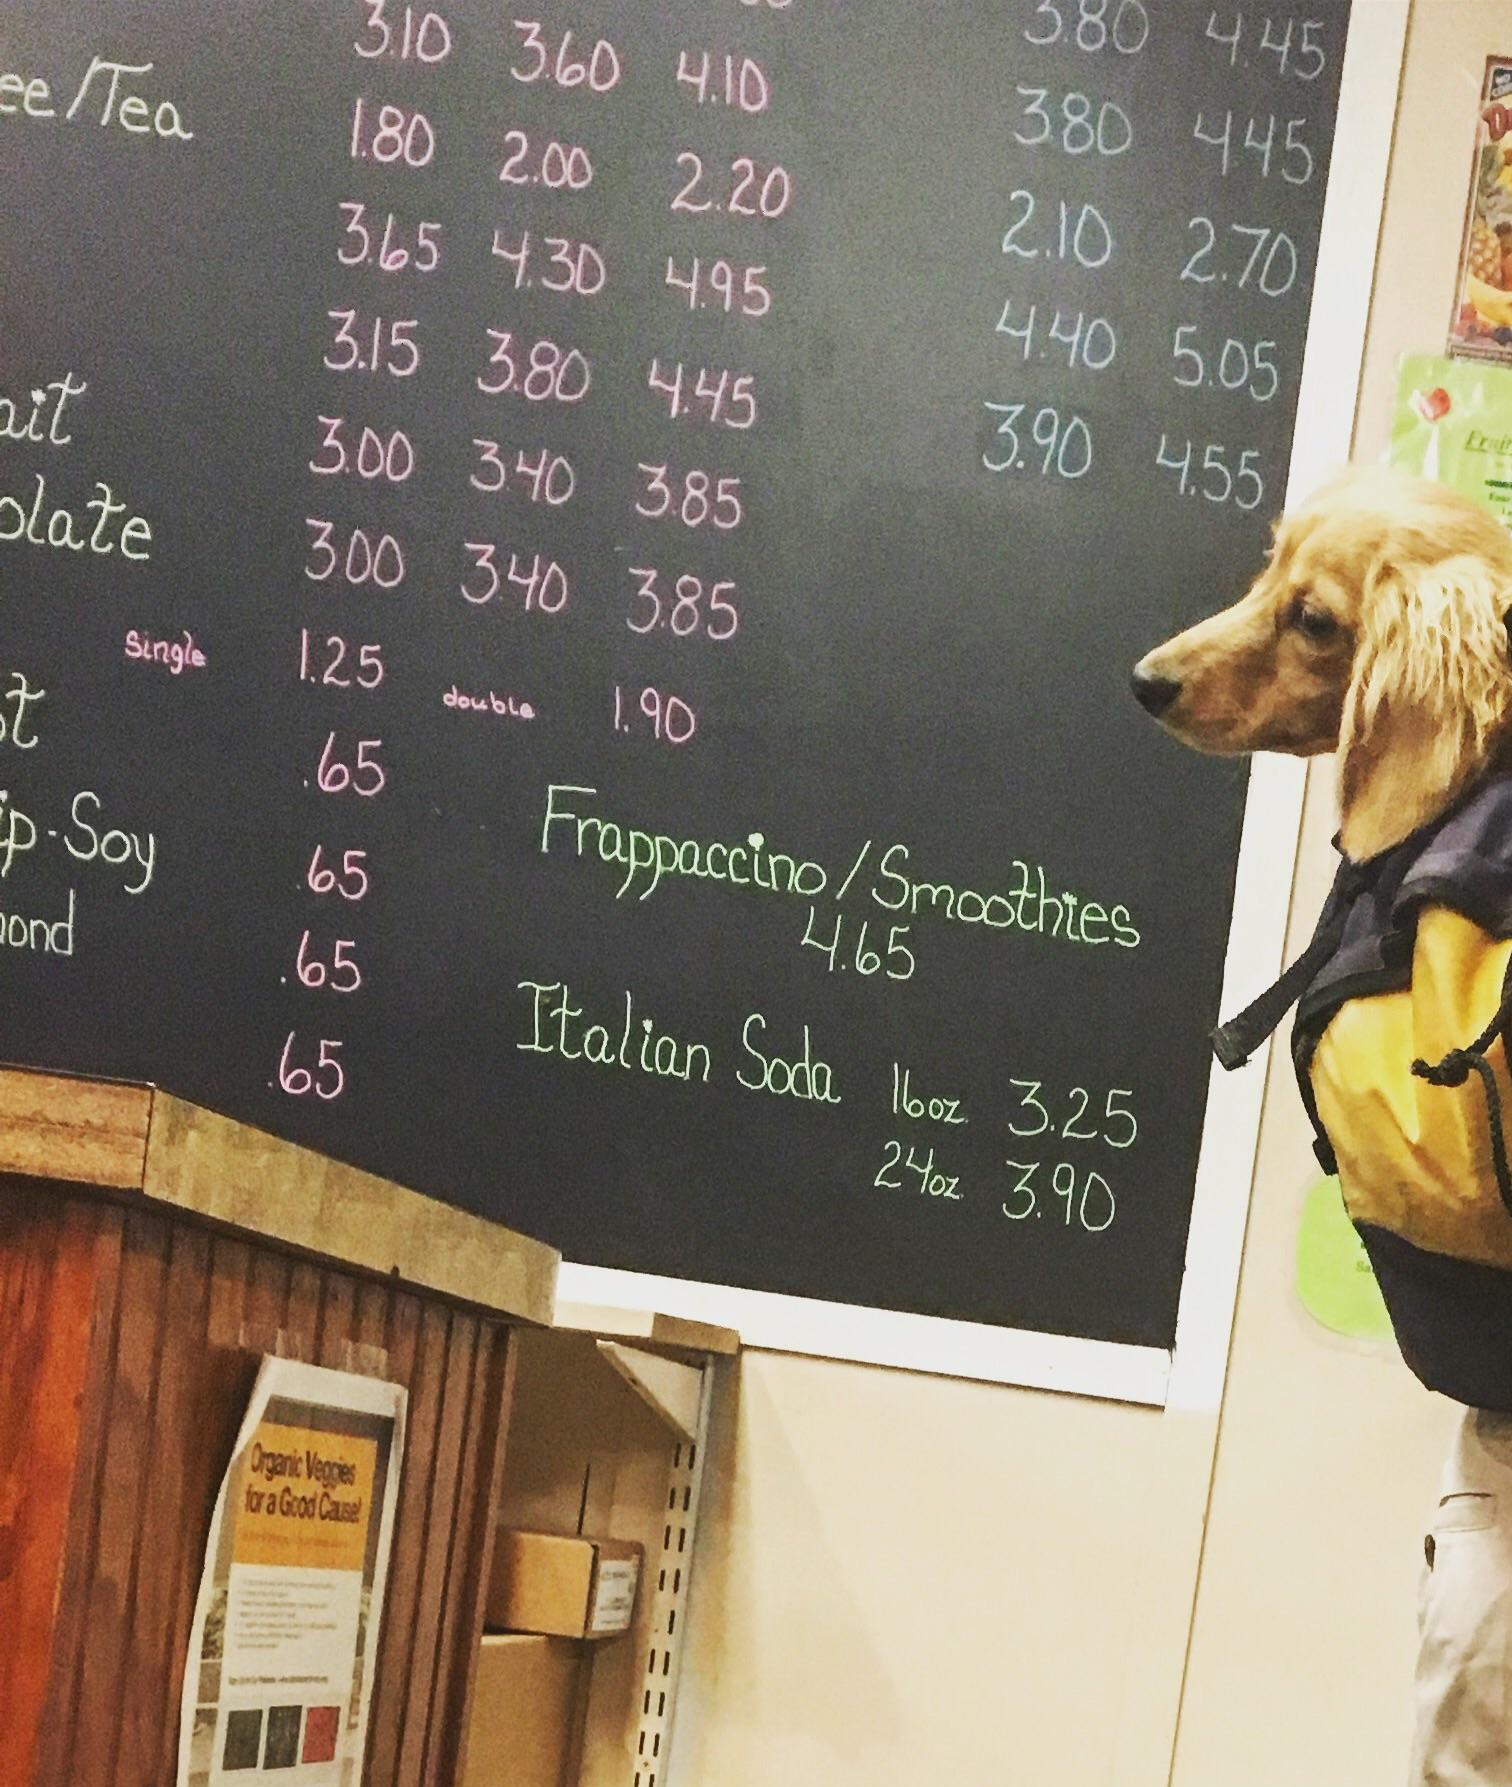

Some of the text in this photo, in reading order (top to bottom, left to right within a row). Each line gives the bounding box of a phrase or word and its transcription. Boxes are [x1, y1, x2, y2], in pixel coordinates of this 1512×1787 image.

[354, 0, 769, 113] 3.10 3.60 4.10
[351, 98, 435, 167] 1.80
[499, 130, 593, 189] 2.00
[670, 151, 792, 218] 2.20
[337, 201, 772, 317] 3.65 4.30 4.95
[1001, 189, 1297, 297] 2.10 2.70
[323, 309, 756, 429] 3.15 3.80 4.45
[994, 299, 1279, 402] 4.40 5.05
[308, 415, 414, 482] 3.00
[635, 462, 742, 529] 3.85
[982, 400, 1264, 510] 3.90 4.55
[627, 567, 739, 641] 3.85
[299, 628, 384, 689] 1.25
[442, 685, 536, 720] double
[614, 686, 696, 744] 1.90
[302, 731, 386, 797] .65
[279, 929, 362, 993] .65
[800, 907, 918, 981] 4.65
[266, 1031, 345, 1100] .65
[516, 980, 711, 1082] Italian
[735, 1013, 842, 1104] Soda
[1007, 1078, 1138, 1149] 3.25
[1001, 1159, 1116, 1232] 3.90
[245, 1484, 362, 1524] for a Good Cause!
[251, 1442, 357, 1489] Organic Veggies
